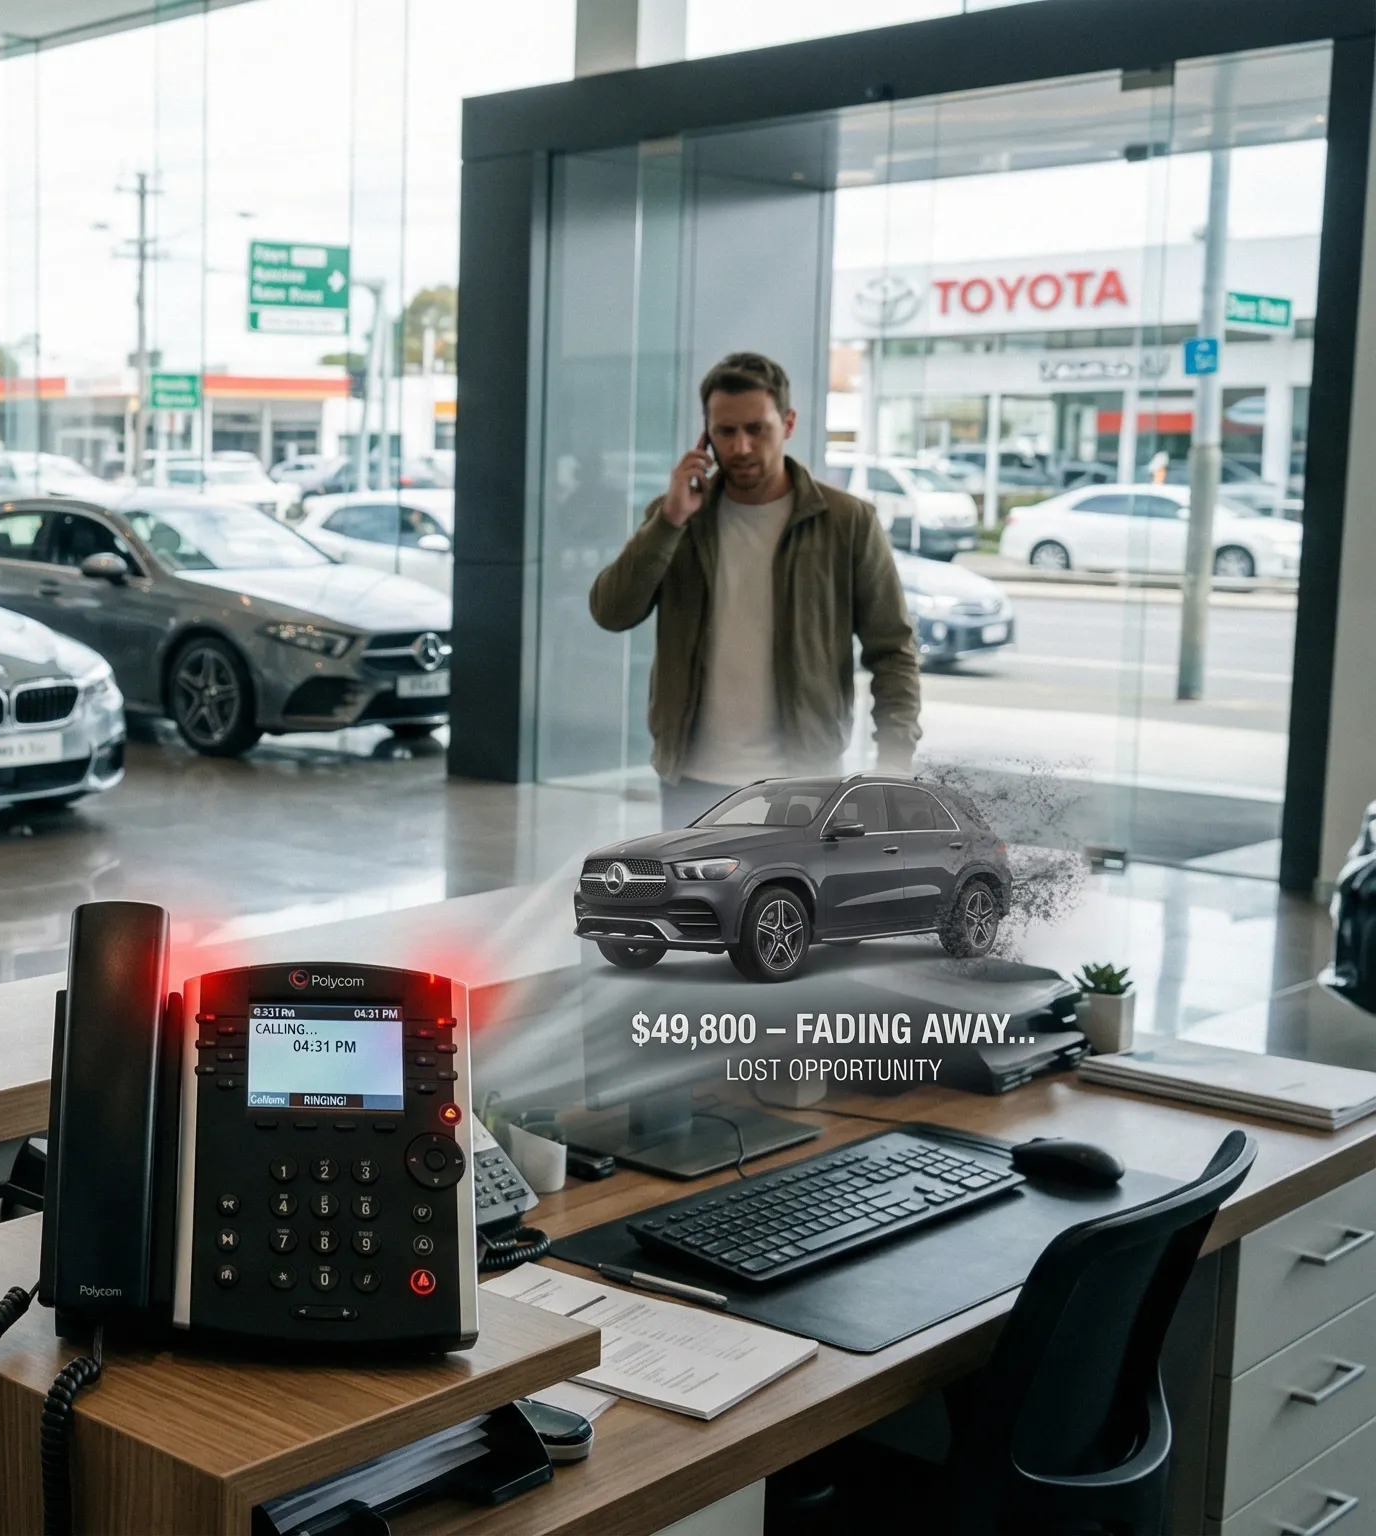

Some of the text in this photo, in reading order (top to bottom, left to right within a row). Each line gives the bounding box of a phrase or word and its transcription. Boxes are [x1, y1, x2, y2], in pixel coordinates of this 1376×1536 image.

[932, 268, 1128, 315] TOYOTA
[312, 974, 364, 989] Polycom
[382, 1009, 398, 1019] PM
[255, 1023, 318, 1035] CALLING...
[293, 1039, 356, 1053] 04:31 PM
[281, 1165, 286, 1178] 1
[320, 1166, 329, 1179] 2
[362, 1166, 370, 1179] 3
[279, 1200, 288, 1212] 4
[279, 1234, 288, 1248] 7
[320, 1236, 329, 1250] 8
[362, 1238, 371, 1251] 9
[320, 1273, 329, 1286] 0
[79, 1284, 122, 1298] Polycom
